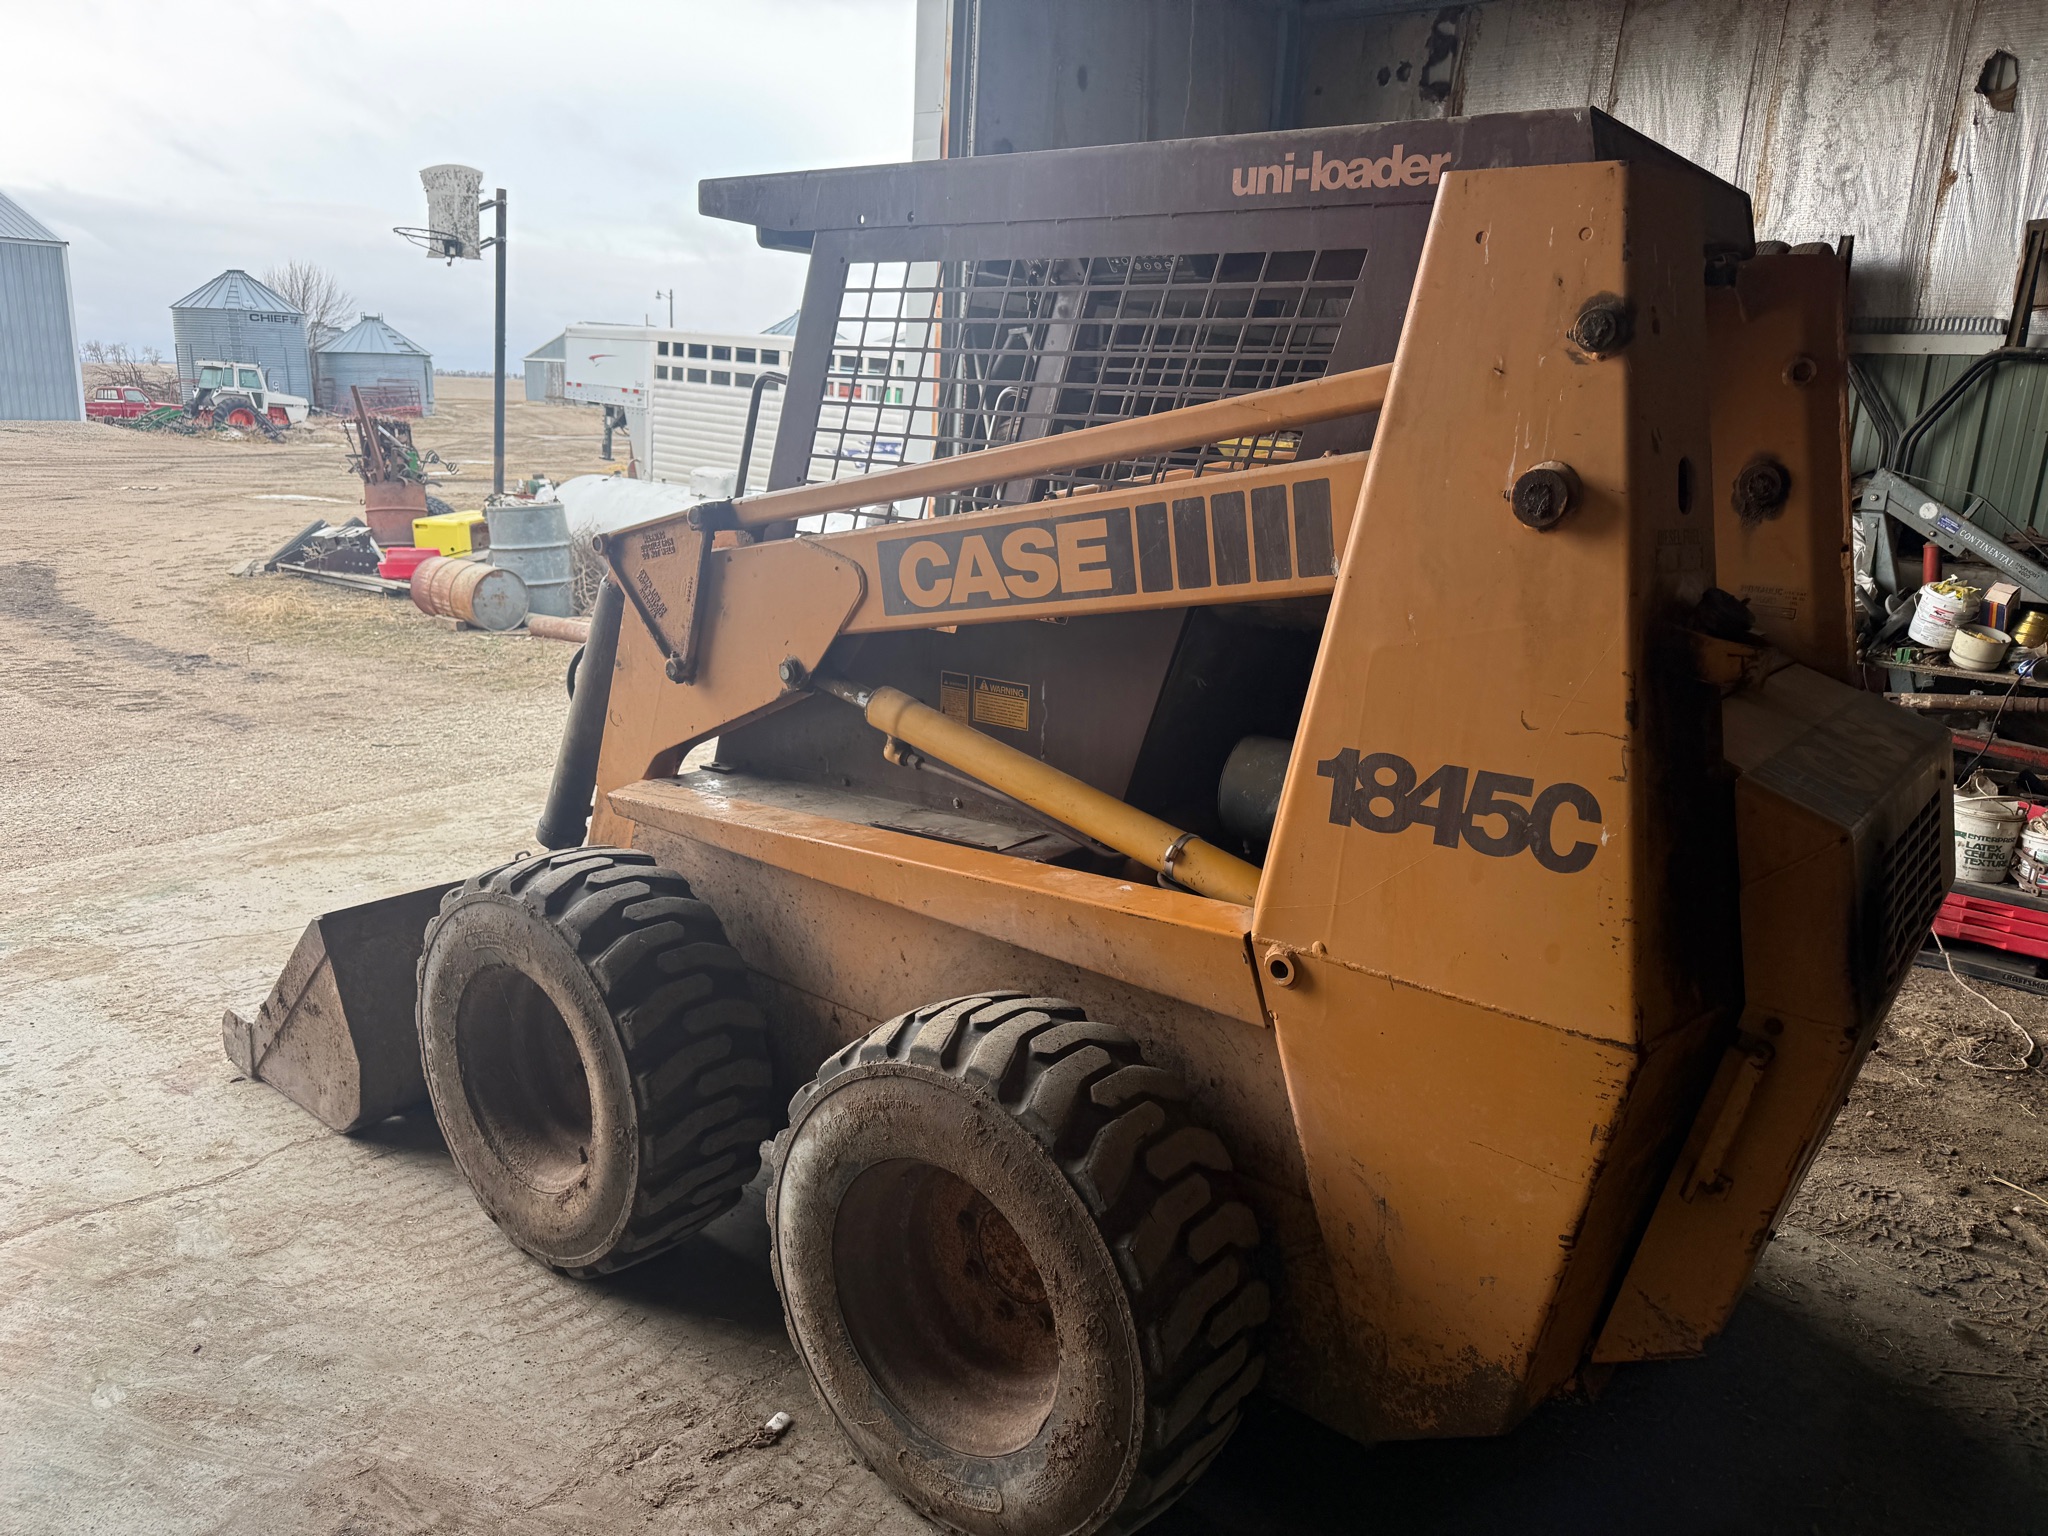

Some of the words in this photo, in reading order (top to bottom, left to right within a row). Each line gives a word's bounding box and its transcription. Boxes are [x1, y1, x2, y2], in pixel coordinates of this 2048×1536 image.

[1232, 144, 1451, 196] uni-loader
[249, 313, 289, 324] CHIEF
[1959, 529, 2014, 568] CONTINENTAL
[899, 518, 1112, 608] CASE
[989, 684, 1024, 698] WARNING
[1316, 746, 1603, 874] 1845C
[1964, 849, 2006, 860] CEILING
[1965, 841, 2003, 852] LATEX
